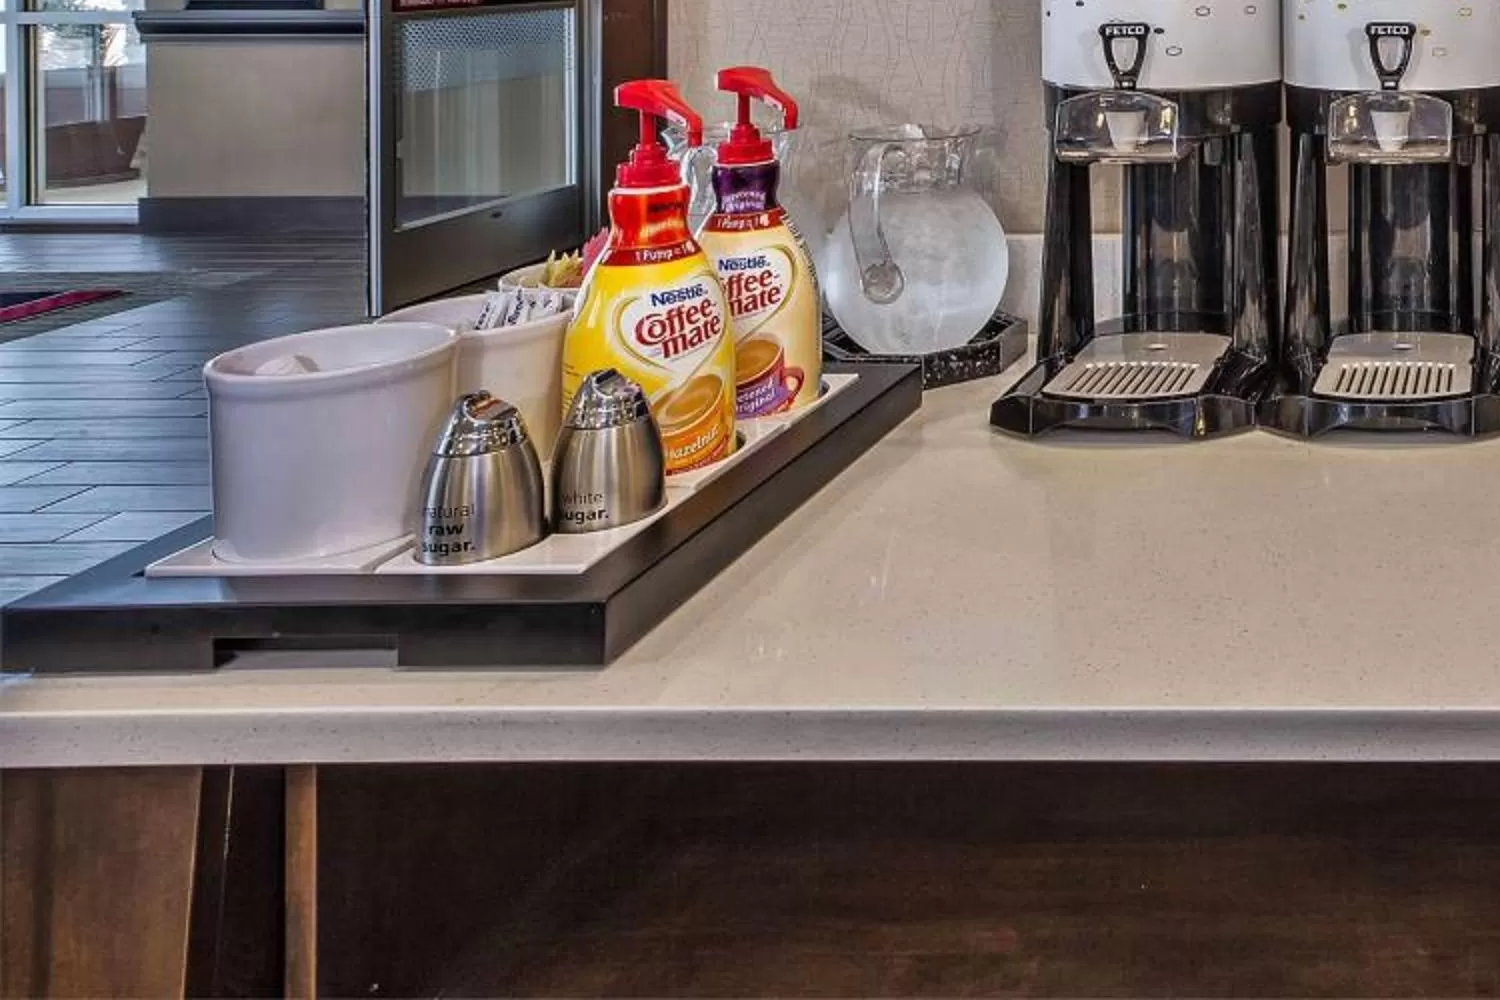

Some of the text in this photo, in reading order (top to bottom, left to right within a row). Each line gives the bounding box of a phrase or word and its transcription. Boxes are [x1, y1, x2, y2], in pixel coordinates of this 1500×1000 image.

[1104, 26, 1146, 36] FETCO
[1369, 24, 1410, 36] FETCO
[661, 313, 721, 359] mate
[562, 508, 609, 525] ugar.
[429, 524, 464, 536] raw
